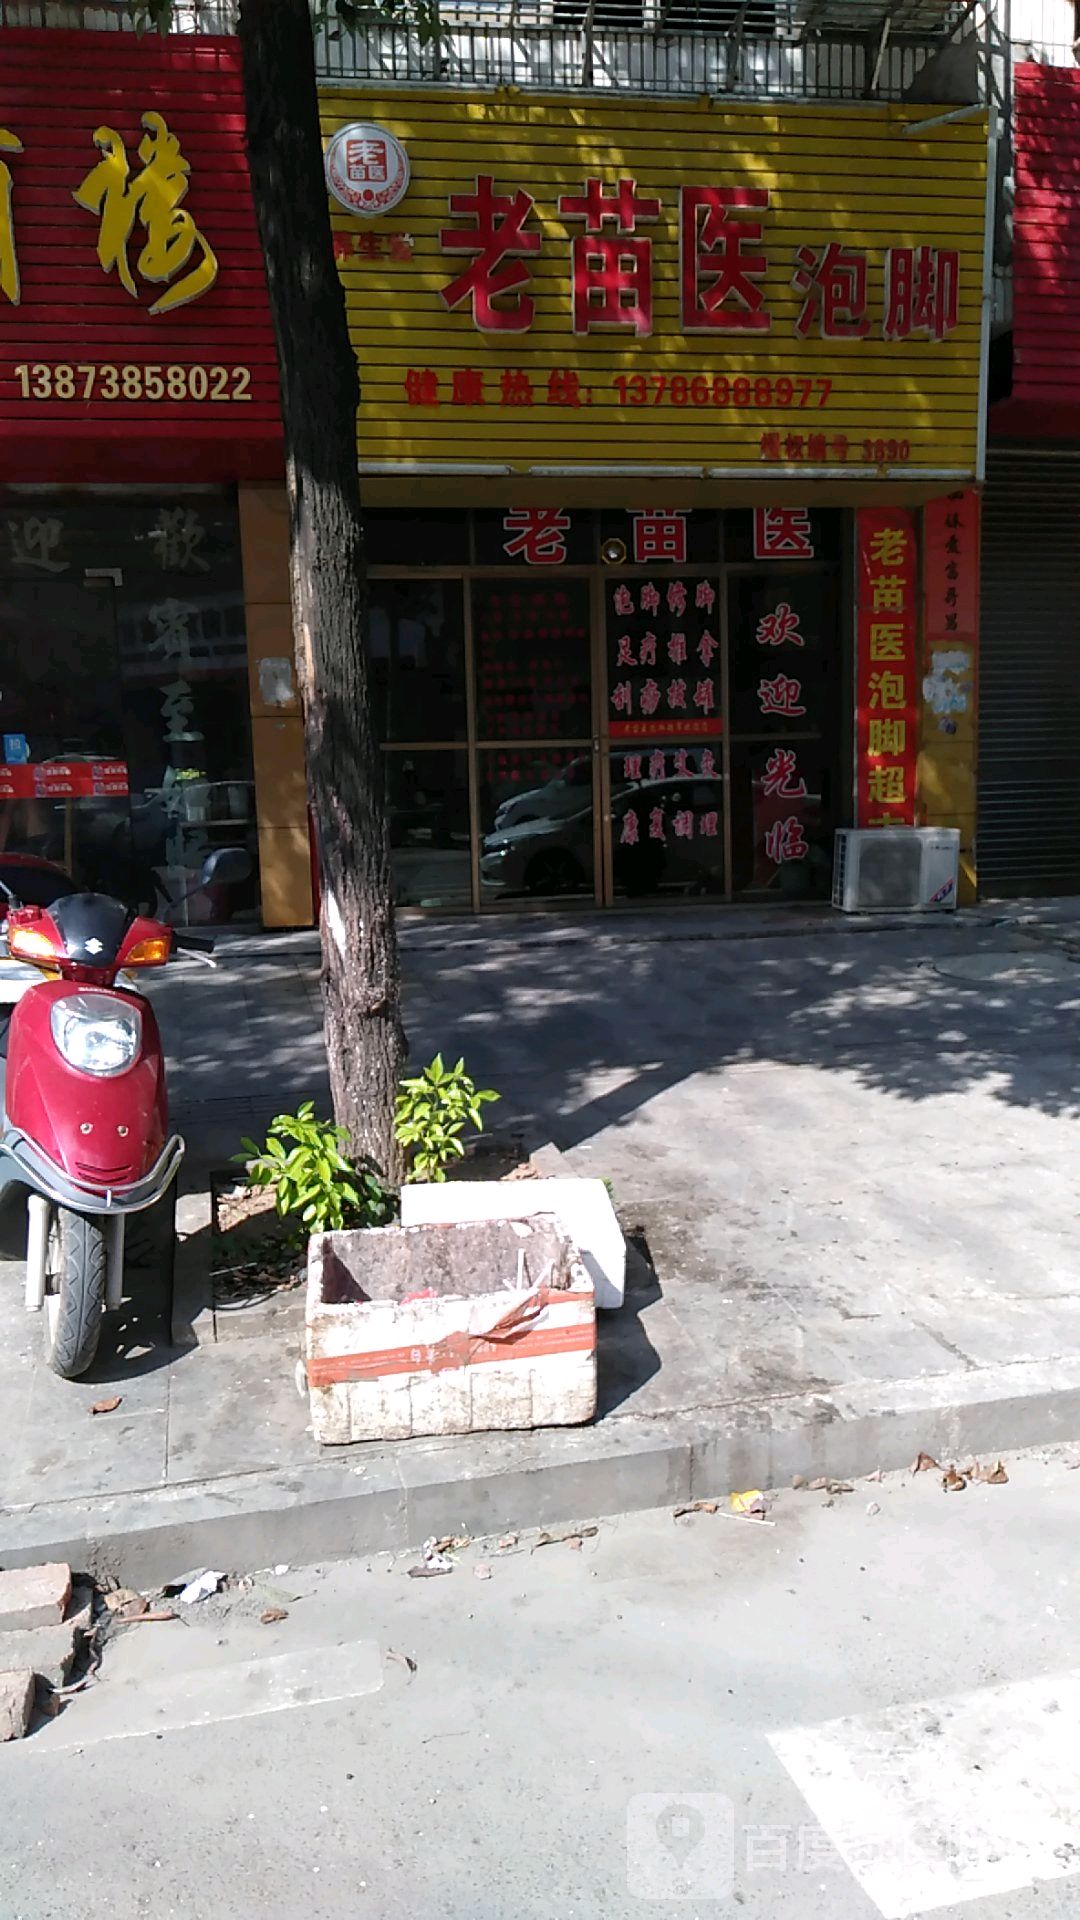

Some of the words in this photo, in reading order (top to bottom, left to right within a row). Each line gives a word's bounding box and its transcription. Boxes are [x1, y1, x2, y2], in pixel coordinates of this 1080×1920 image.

[439, 174, 961, 342] 老苗医泡脚
[14, 364, 252, 401] 13873858022
[613, 374, 834, 409] 13786888977
[502, 507, 815, 565] 老苗医
[612, 578, 717, 617] 泡脚修脚
[615, 629, 721, 668] 足疗推拿
[756, 601, 809, 865] 欢迎光临
[623, 747, 719, 781] 理疗艾灸
[619, 806, 719, 847] 康复调理
